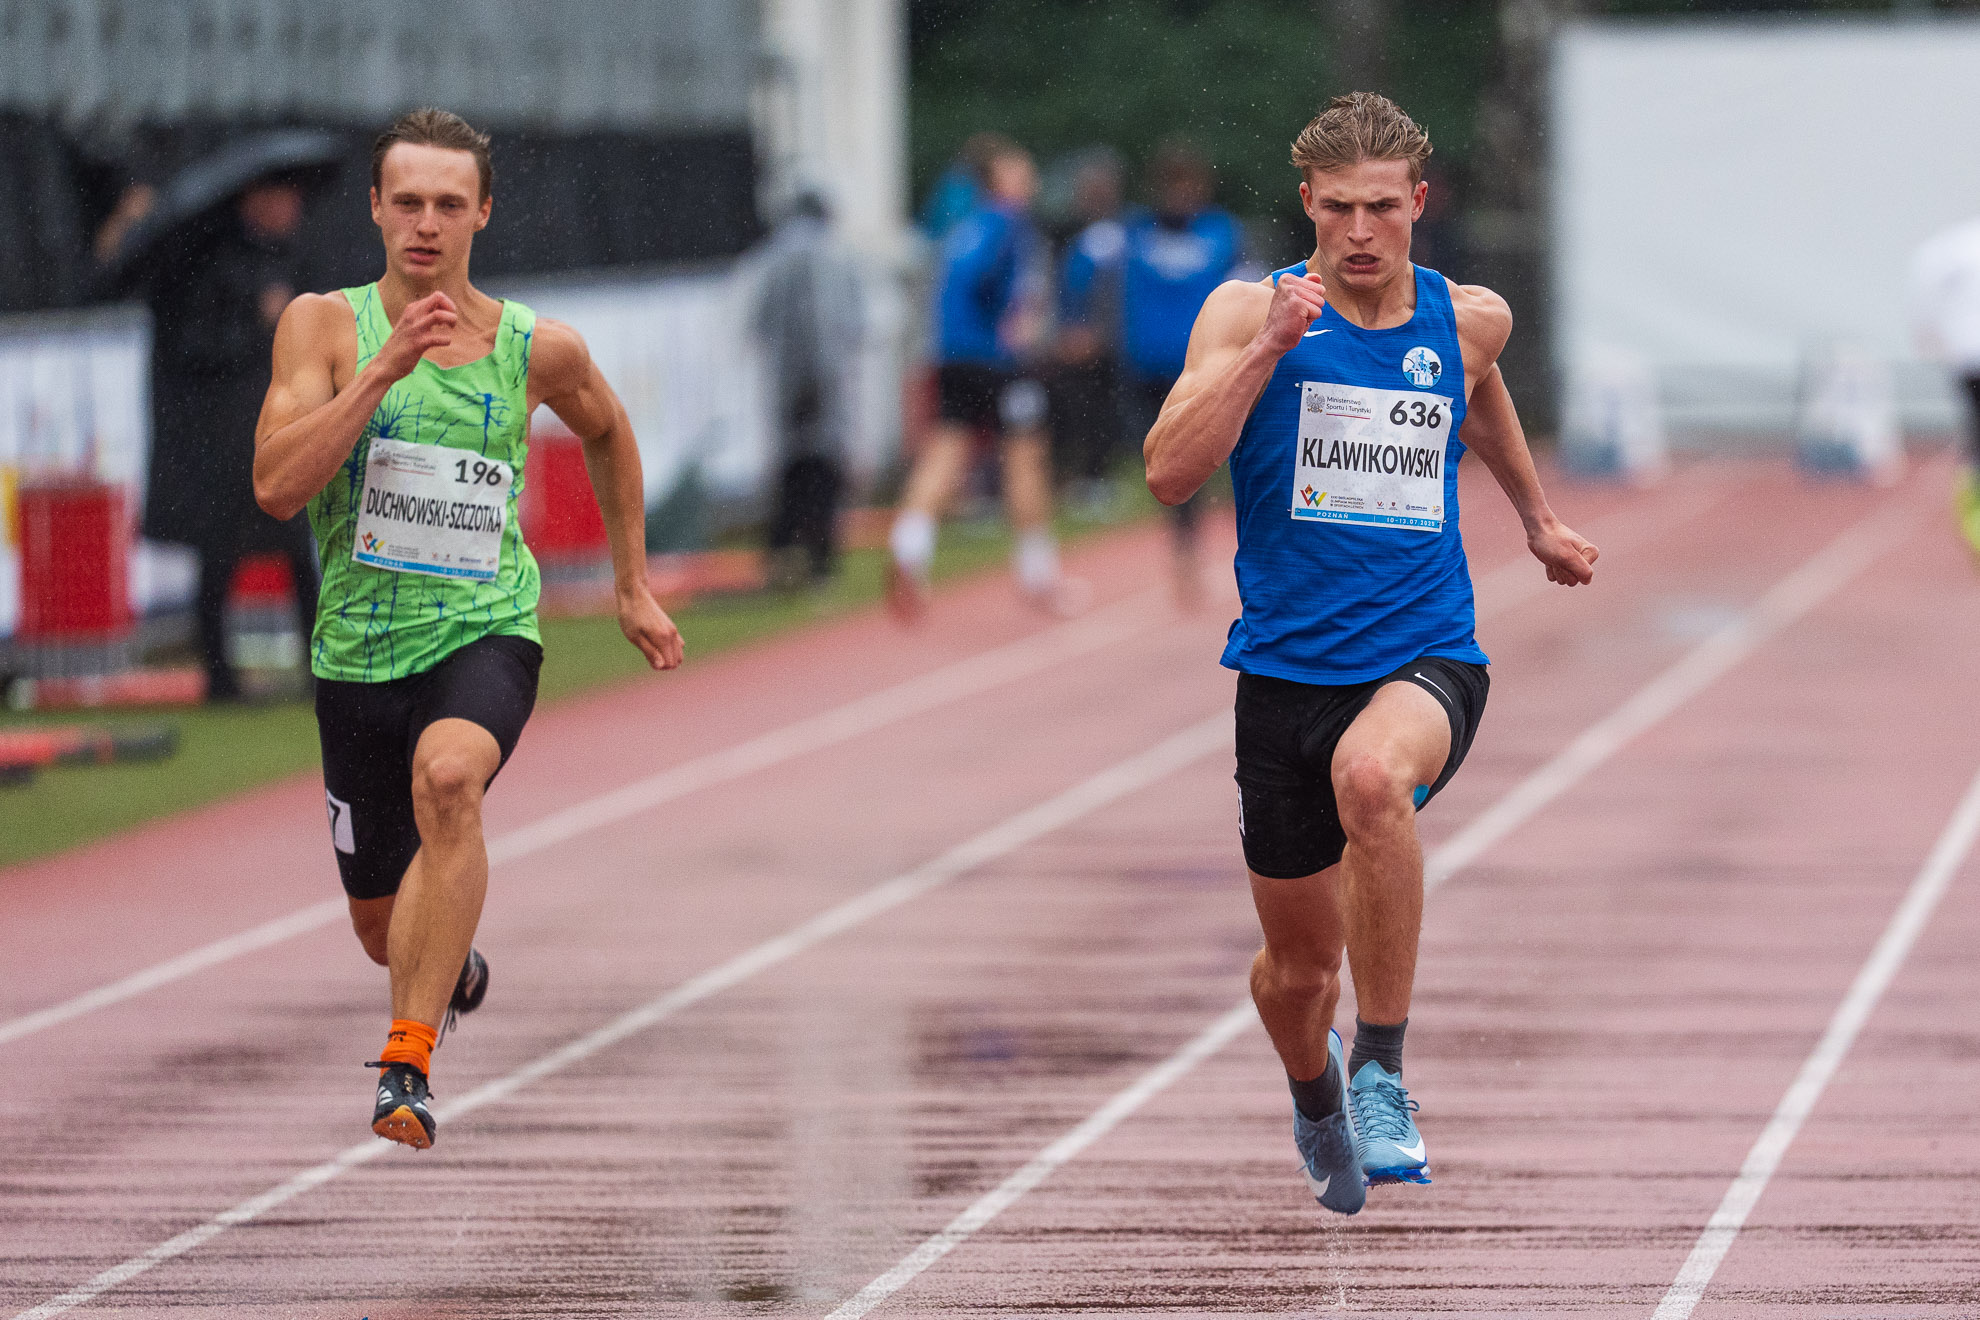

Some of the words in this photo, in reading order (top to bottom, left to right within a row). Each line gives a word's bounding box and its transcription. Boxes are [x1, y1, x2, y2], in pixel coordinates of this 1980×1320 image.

[1326, 403, 1344, 412] Sportu
[1349, 405, 1372, 414] Turystyki
[1327, 396, 1362, 406] Ministerstwo
[1389, 400, 1442, 429] 636
[1302, 437, 1440, 480] KLAWIKOWSKI
[455, 459, 501, 486] 196
[366, 487, 501, 533] DUCHNOWSKI-SZCZOTKA
[1316, 511, 1349, 520] POZNAŃ
